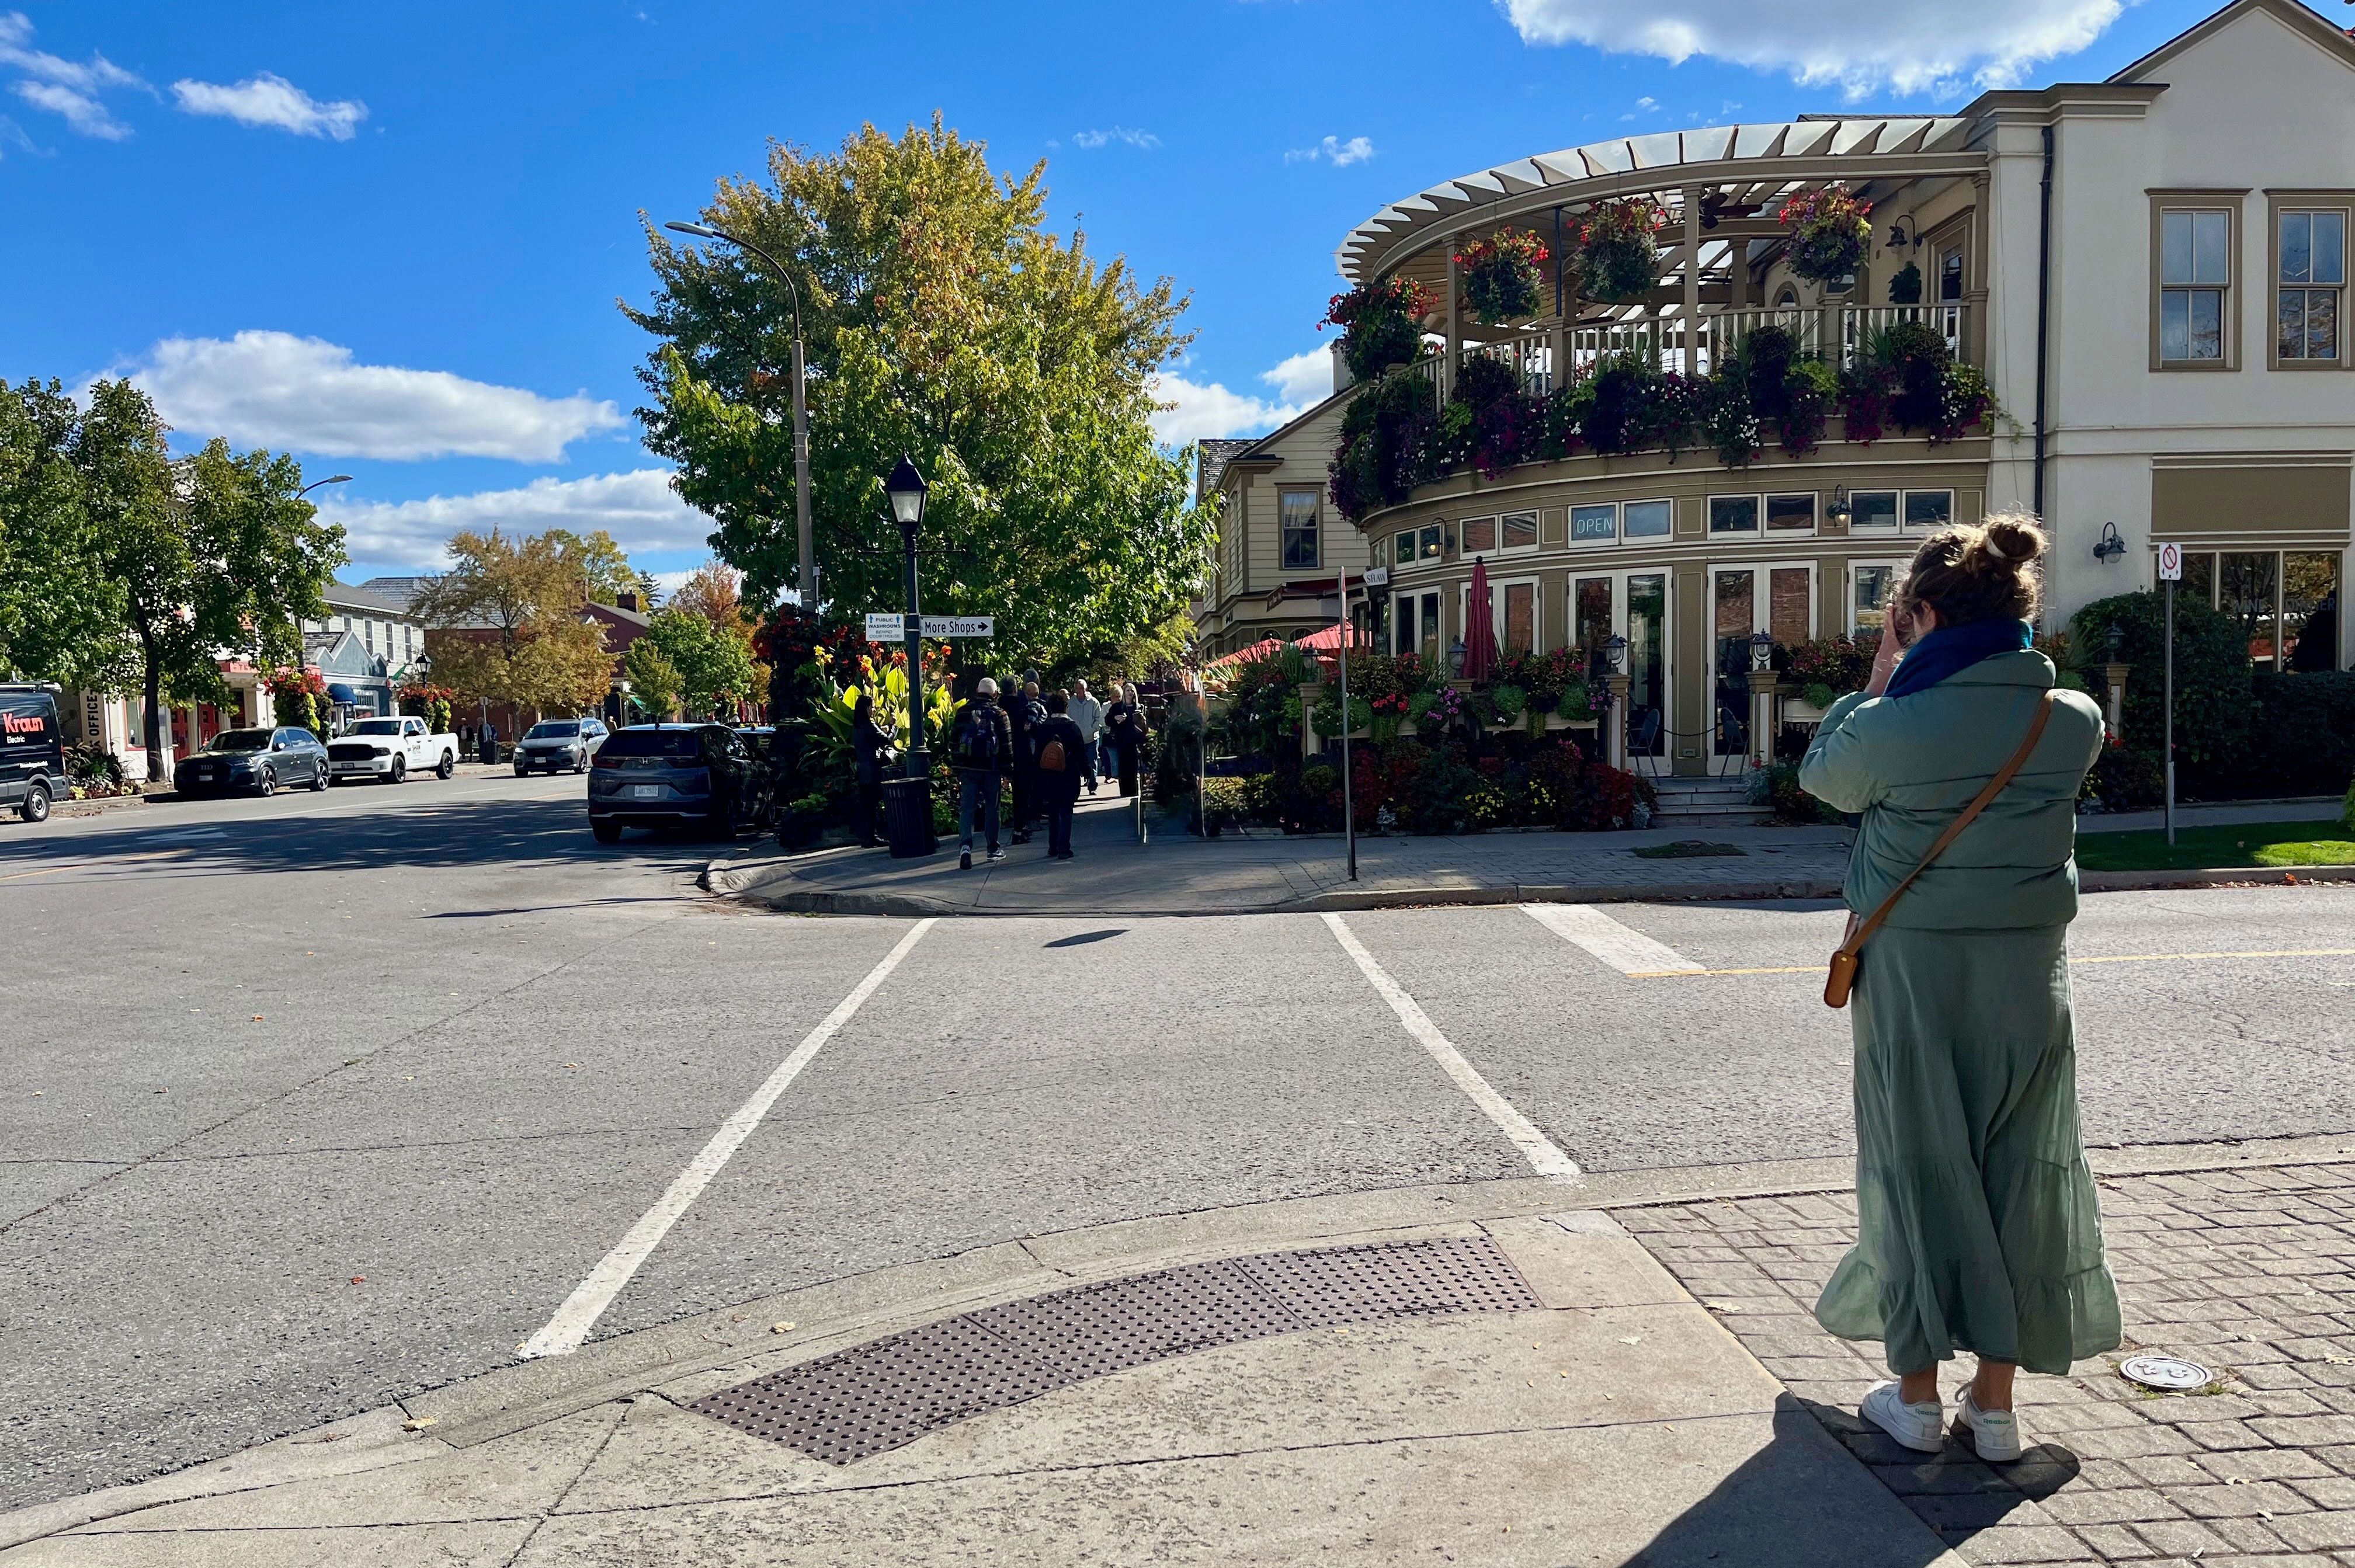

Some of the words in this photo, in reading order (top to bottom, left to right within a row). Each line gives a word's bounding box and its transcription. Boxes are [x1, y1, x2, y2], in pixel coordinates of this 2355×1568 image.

[1576, 517, 1612, 534] OPEN
[1367, 573, 1385, 583] SHAW
[925, 621, 946, 633] More
[949, 621, 975, 635] Shops
[2, 712, 44, 733] Kraun
[86, 695, 100, 736] OFFICE
[6, 735, 26, 744] Electric
